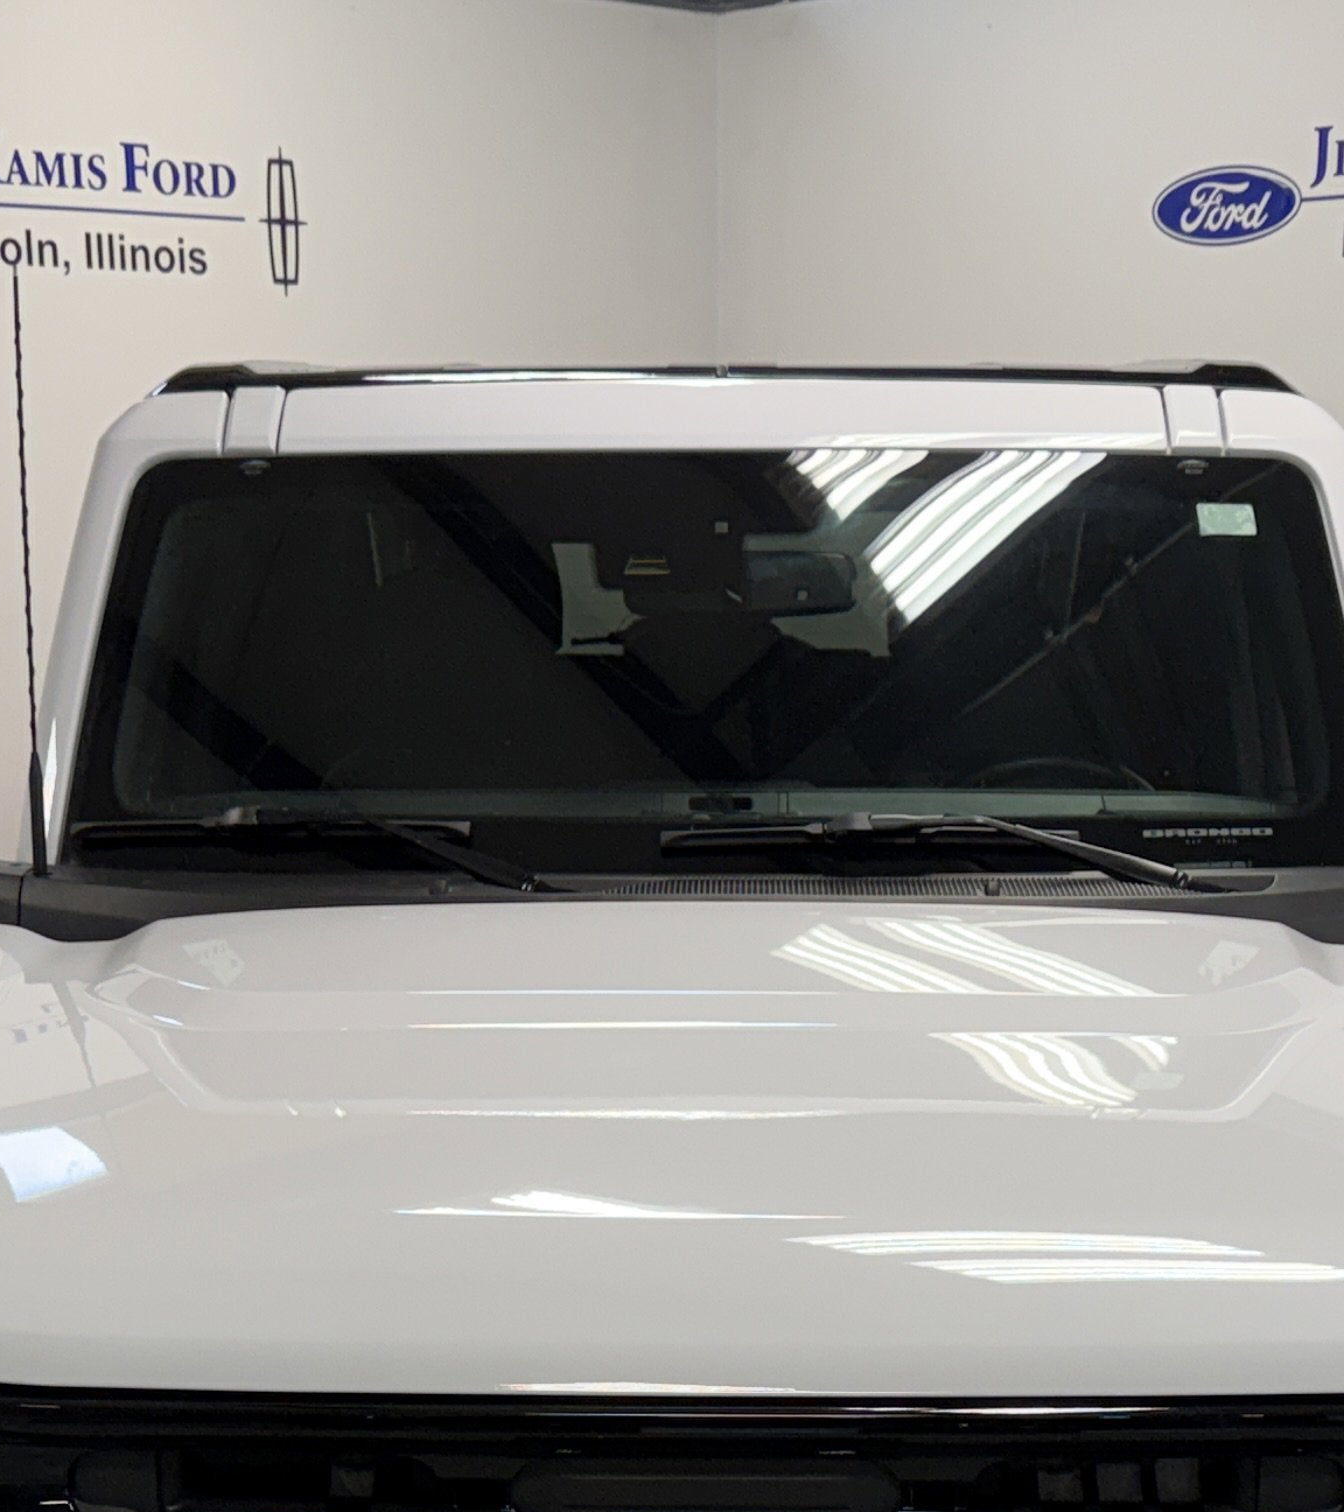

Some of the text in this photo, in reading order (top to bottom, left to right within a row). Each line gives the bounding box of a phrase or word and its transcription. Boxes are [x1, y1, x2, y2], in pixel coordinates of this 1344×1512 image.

[119, 142, 237, 198] FORD
[1180, 171, 1269, 233] Ford
[84, 232, 208, 276] Illinois
